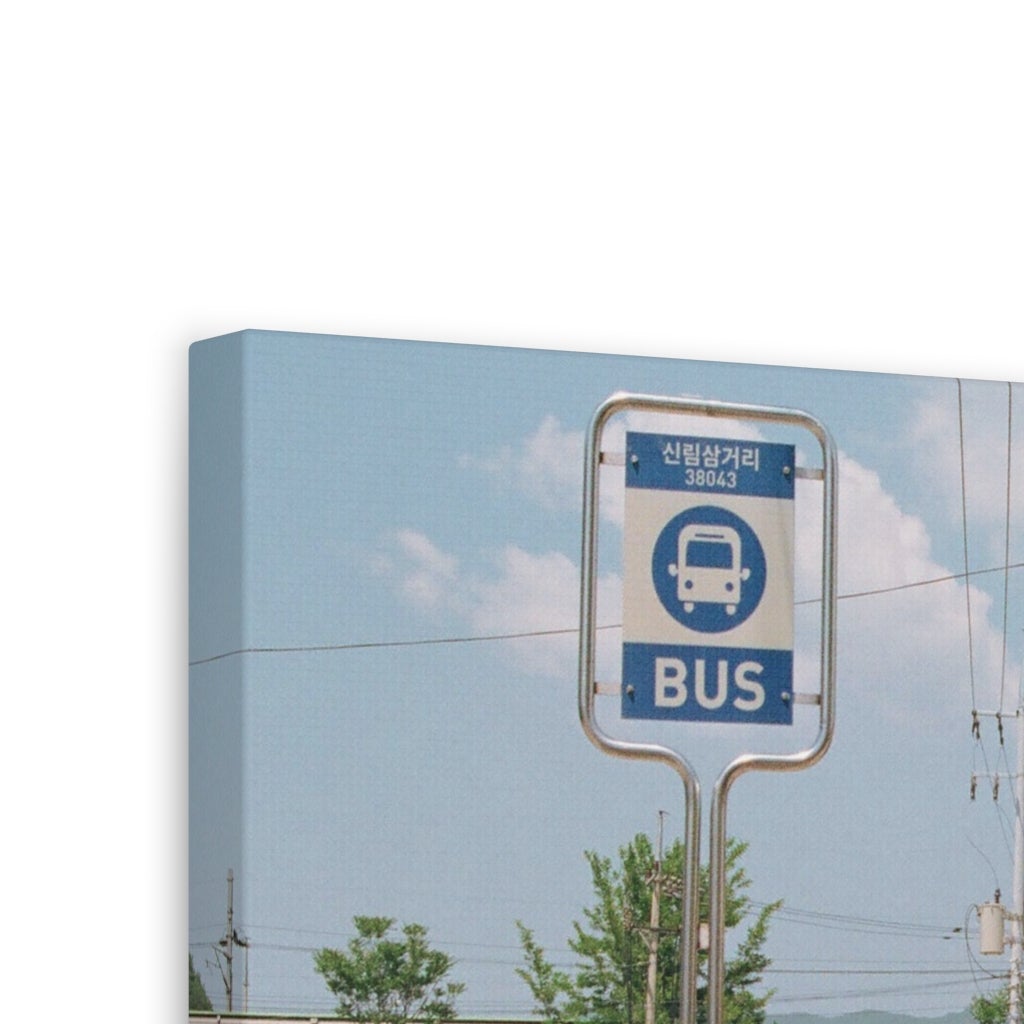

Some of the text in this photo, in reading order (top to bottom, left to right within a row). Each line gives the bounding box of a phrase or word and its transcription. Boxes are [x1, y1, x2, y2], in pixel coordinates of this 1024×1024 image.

[662, 442, 760, 470] 신림삼거리
[685, 469, 737, 488] 38043
[653, 657, 766, 712] BUS
